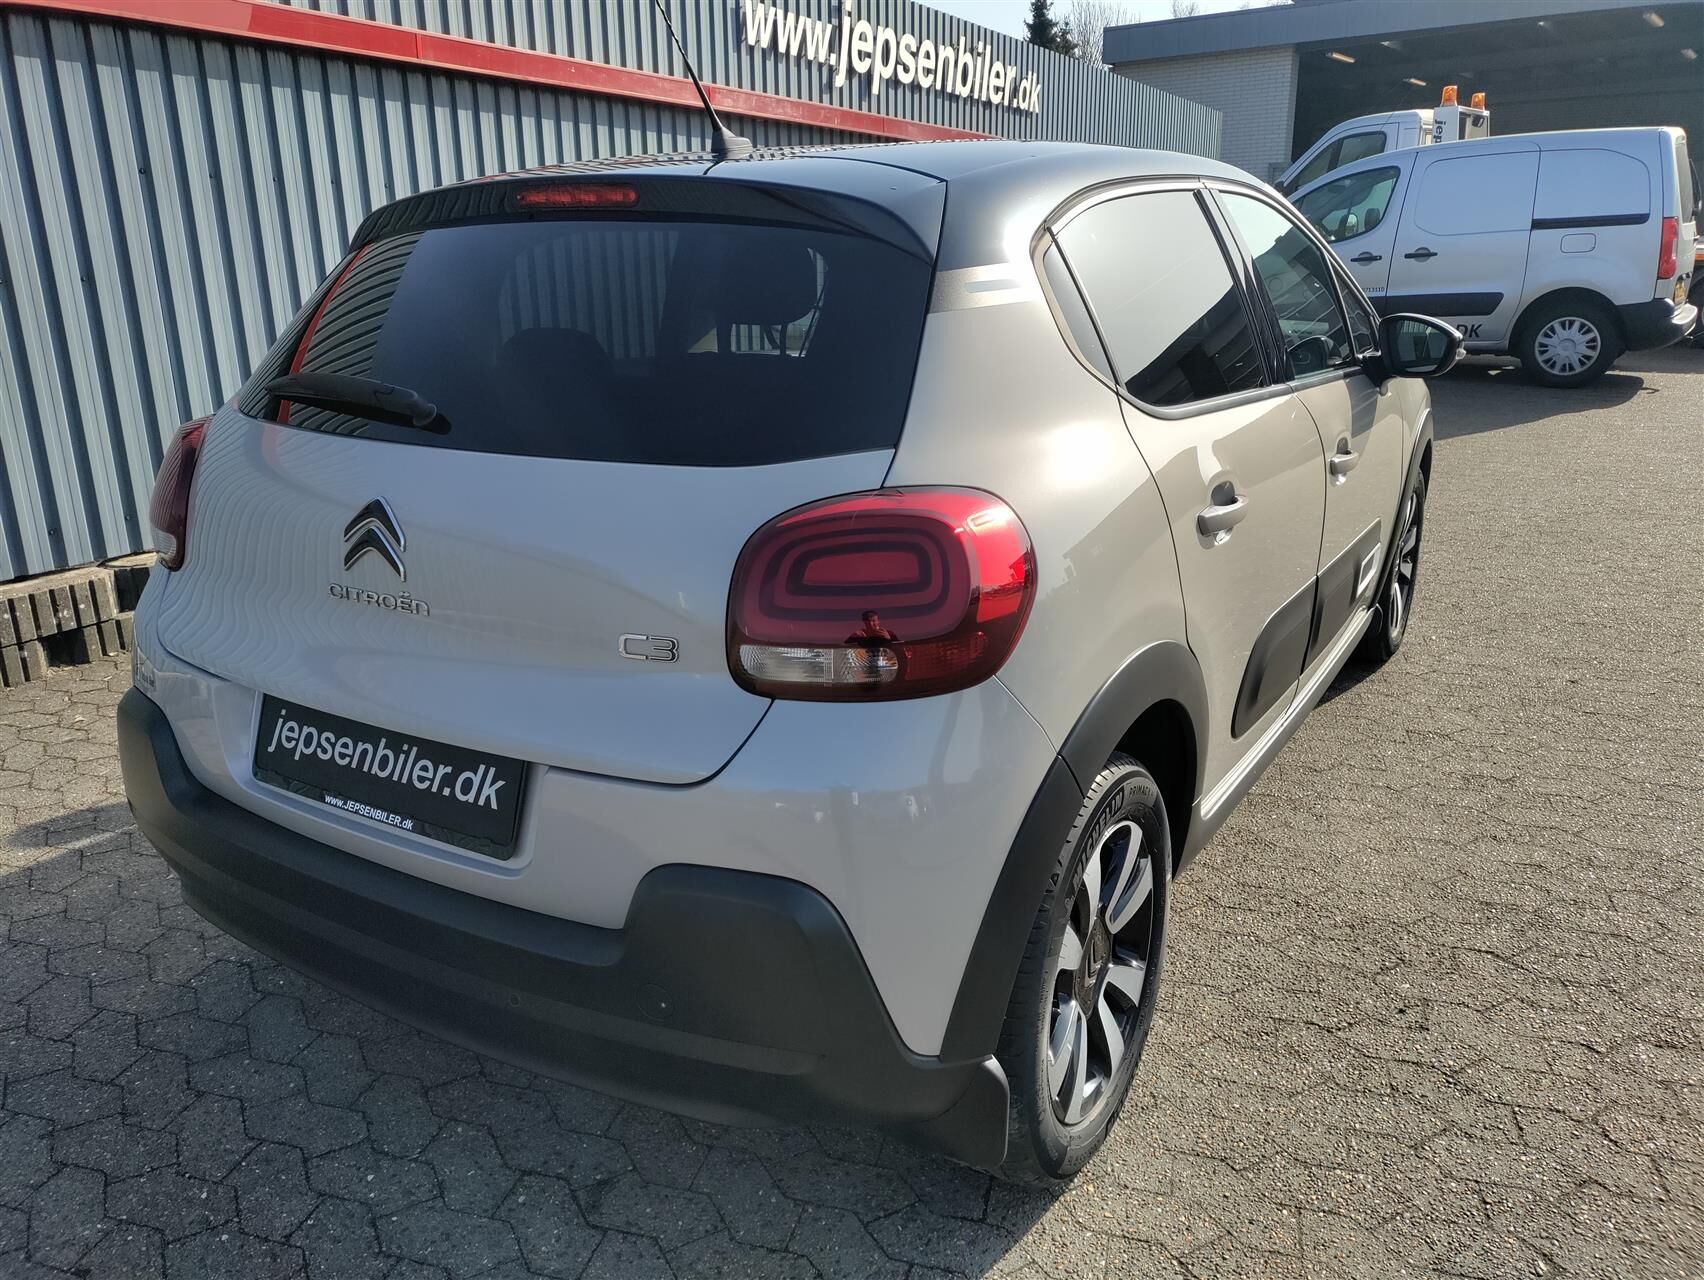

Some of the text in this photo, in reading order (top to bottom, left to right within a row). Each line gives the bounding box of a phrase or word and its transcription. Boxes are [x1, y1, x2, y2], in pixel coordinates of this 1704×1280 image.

[745, 0, 1040, 114] www.jepsenbiler.dk
[1456, 323, 1483, 338] DK
[618, 633, 679, 663] C3
[267, 709, 507, 810] jepsenbiler.dk
[324, 793, 414, 831] www.JEPSENBILER.dk
[1072, 791, 1125, 891] MICHELIN
